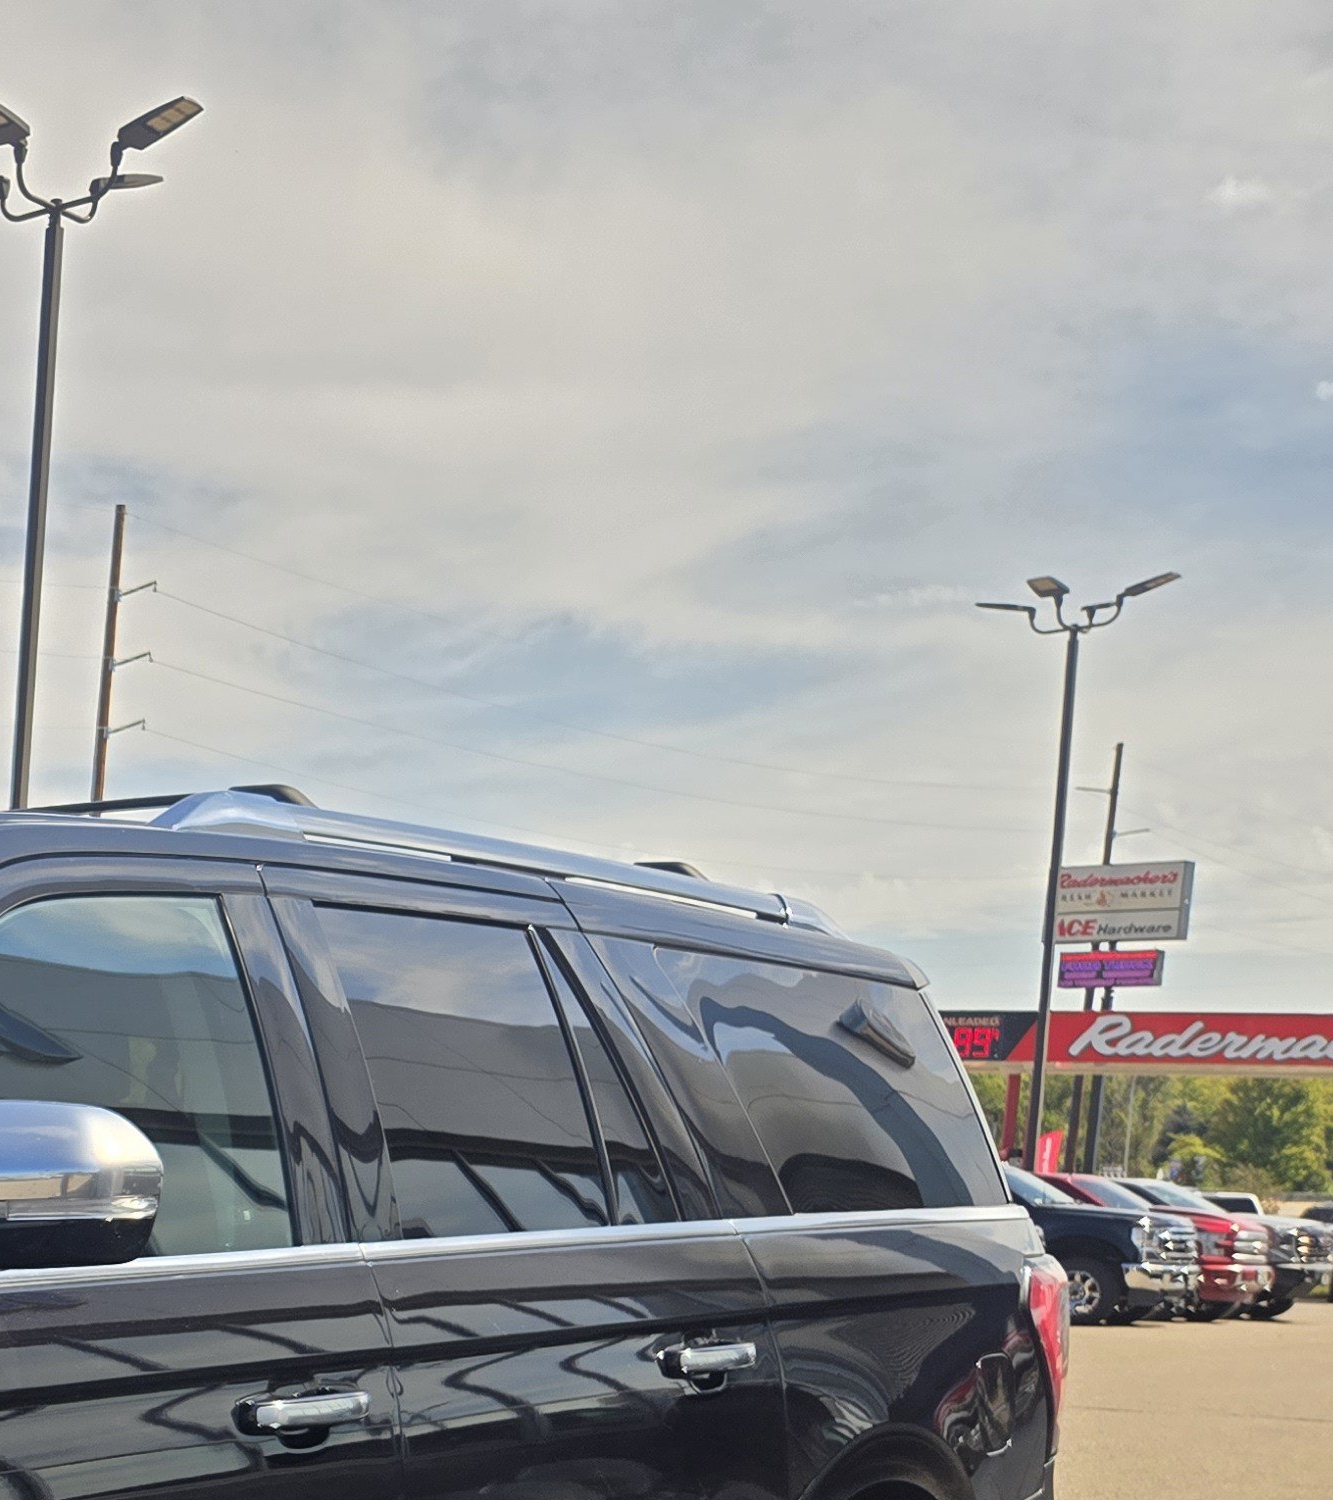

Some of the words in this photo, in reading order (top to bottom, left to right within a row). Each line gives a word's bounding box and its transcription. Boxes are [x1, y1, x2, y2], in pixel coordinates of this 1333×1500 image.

[1059, 870, 1179, 889] Radermacher's
[1061, 893, 1092, 901] RESH
[1057, 919, 1097, 937] ACE
[1097, 923, 1173, 936] Hardware
[942, 1016, 1001, 1027] NLEADED
[1068, 1014, 1333, 1061] Raderma
